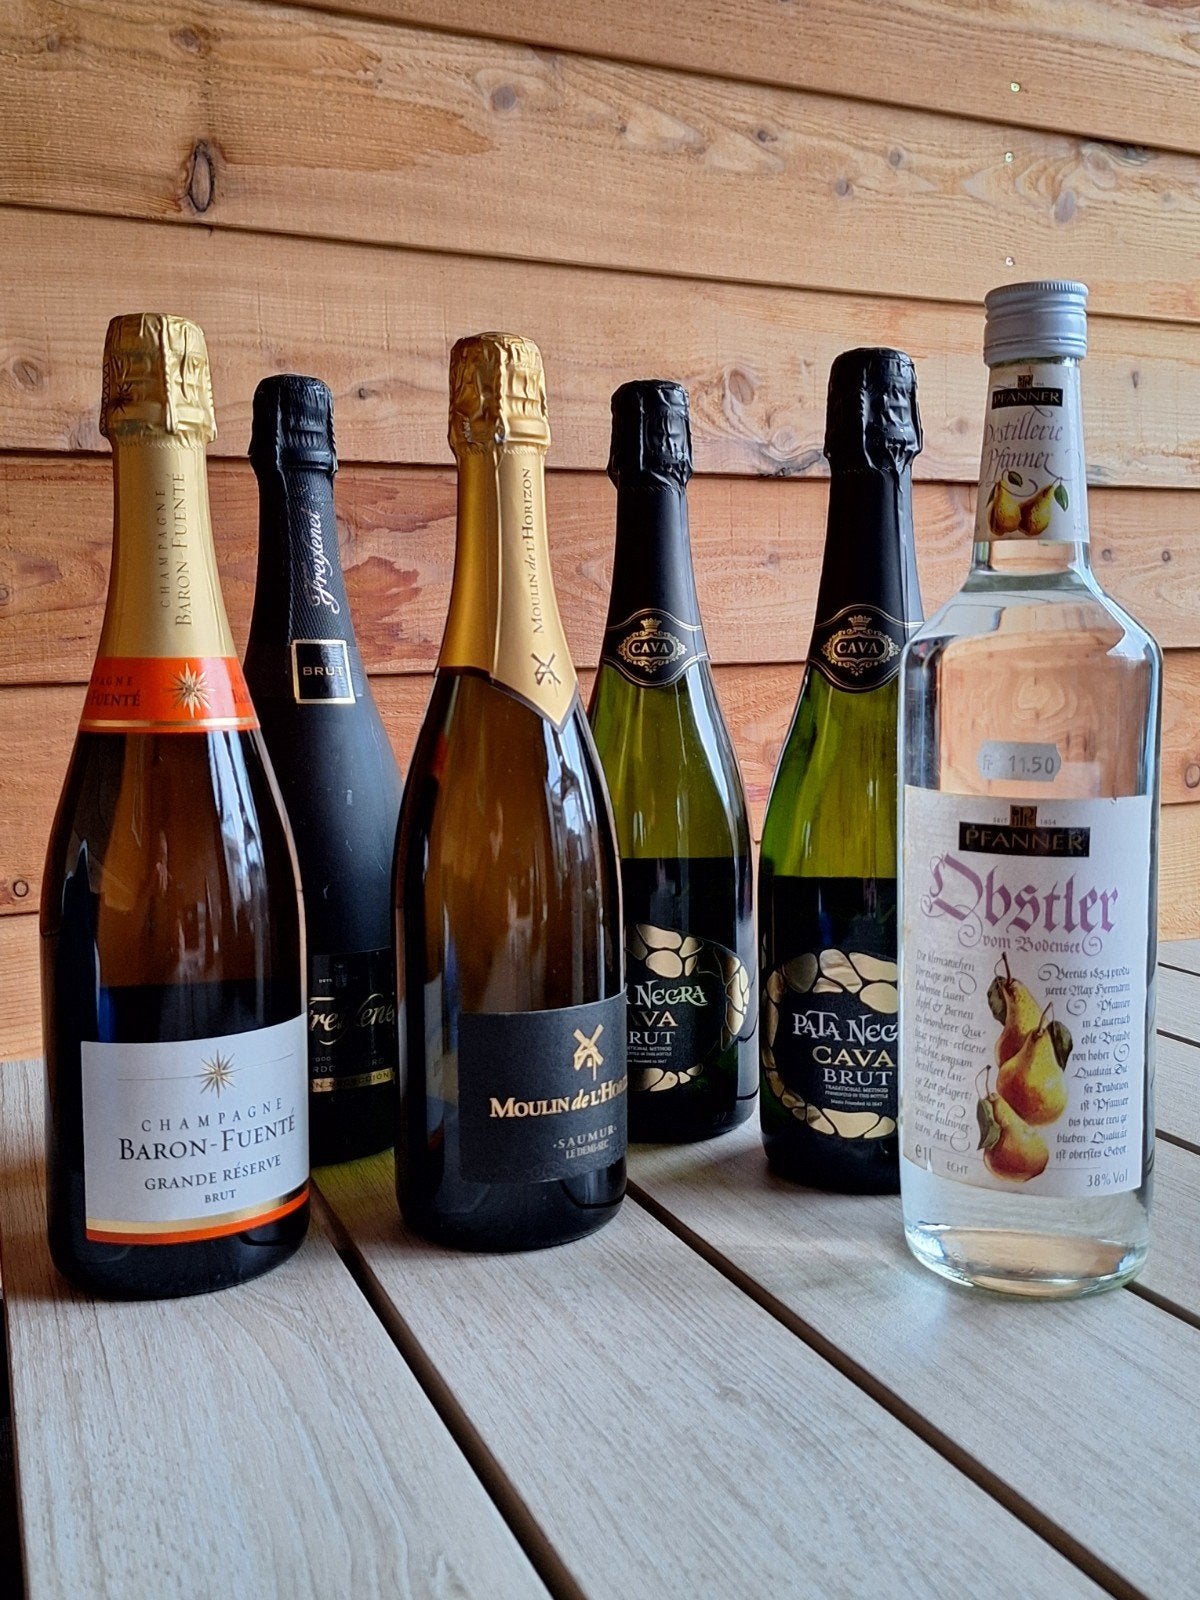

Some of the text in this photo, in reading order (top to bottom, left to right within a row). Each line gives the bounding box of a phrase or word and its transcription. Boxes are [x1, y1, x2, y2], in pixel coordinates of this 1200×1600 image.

[155, 489, 170, 608] CHAMPAGNE
[523, 552, 538, 571] de
[526, 573, 544, 635] MOULIN
[631, 642, 670, 654] CAVA
[836, 641, 879, 654] CAVA
[302, 665, 344, 677] BRUT
[1008, 755, 1055, 775] 11.50
[965, 828, 1083, 850] PFANNER
[920, 853, 1119, 936] Obstler
[983, 935, 1083, 954] vom Bodensee
[634, 979, 709, 1010] NEGRA
[630, 1010, 679, 1028] AVA
[791, 1010, 898, 1047] PATA NEG
[628, 1030, 676, 1045] RUT
[812, 1045, 896, 1068] CAVA
[823, 1068, 893, 1087] BRUT
[488, 1096, 570, 1118] MOULIN
[570, 1088, 591, 1111] de
[141, 1096, 283, 1132] CHAMPAGNE
[118, 1107, 296, 1161] BARON-FUENTÉ
[144, 1154, 282, 1191] GRANDE RÉSERVE
[1112, 1168, 1128, 1184] Vol
[204, 1188, 237, 1204] BRUT
